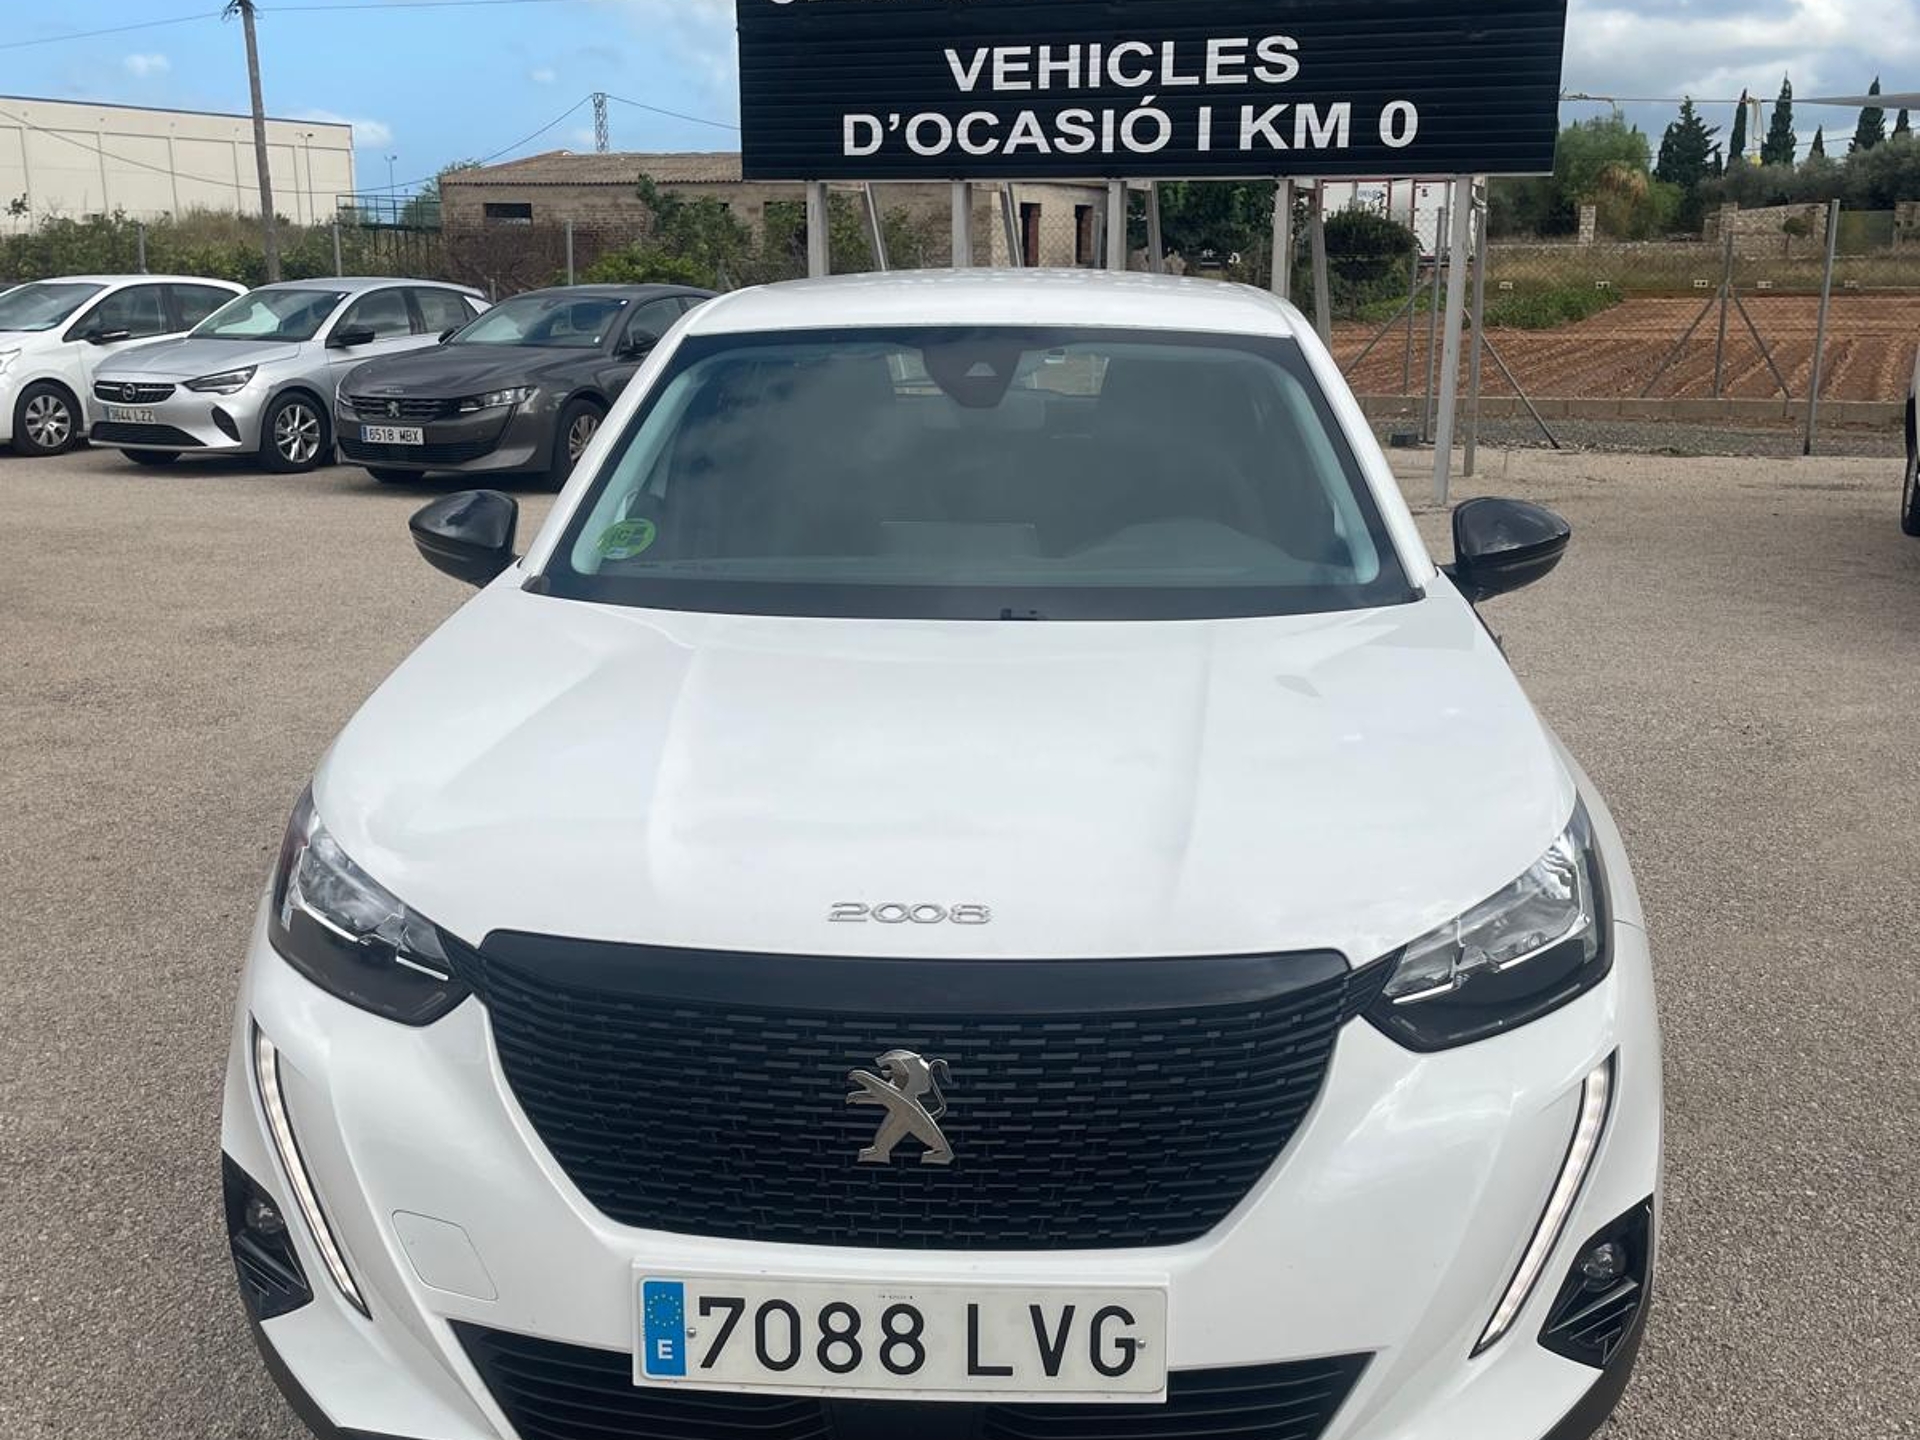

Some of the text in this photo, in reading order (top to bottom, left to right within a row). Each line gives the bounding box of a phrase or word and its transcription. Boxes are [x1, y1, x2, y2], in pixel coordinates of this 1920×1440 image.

[944, 35, 1301, 92] VEHICLES
[842, 95, 1419, 156] D’OCASIÓ I KM 0
[368, 427, 395, 442] 6518
[828, 902, 992, 925] 2008
[657, 1339, 674, 1360] E
[698, 1296, 1138, 1378] 7088 LVG
